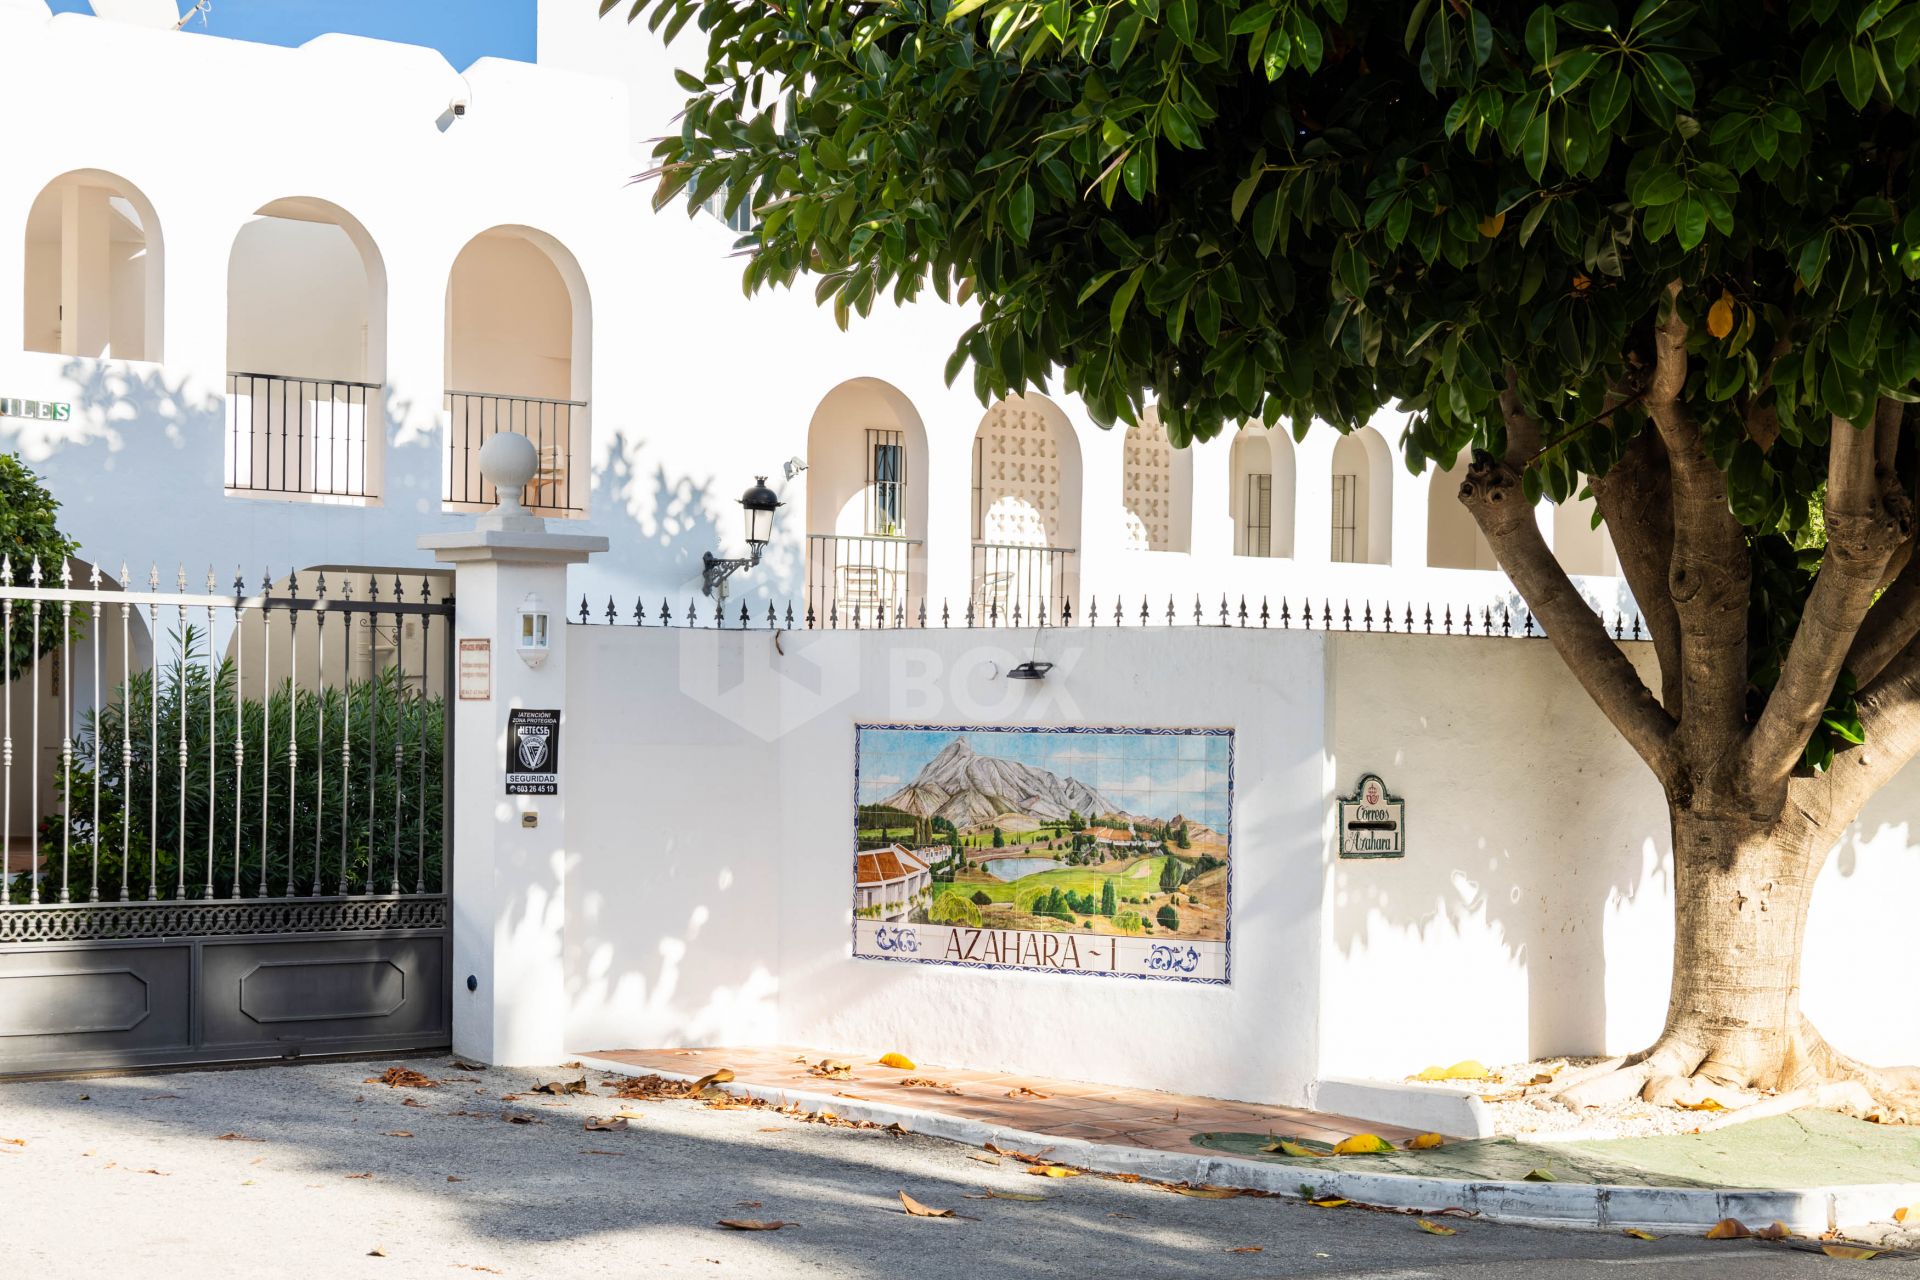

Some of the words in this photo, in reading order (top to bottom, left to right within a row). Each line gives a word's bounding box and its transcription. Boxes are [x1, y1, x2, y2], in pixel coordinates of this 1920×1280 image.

[509, 775, 556, 783] SEGURIDAD
[1356, 805, 1390, 820] Correos
[1345, 831, 1391, 852] Azahara
[944, 928, 1081, 969] AZAHARA
